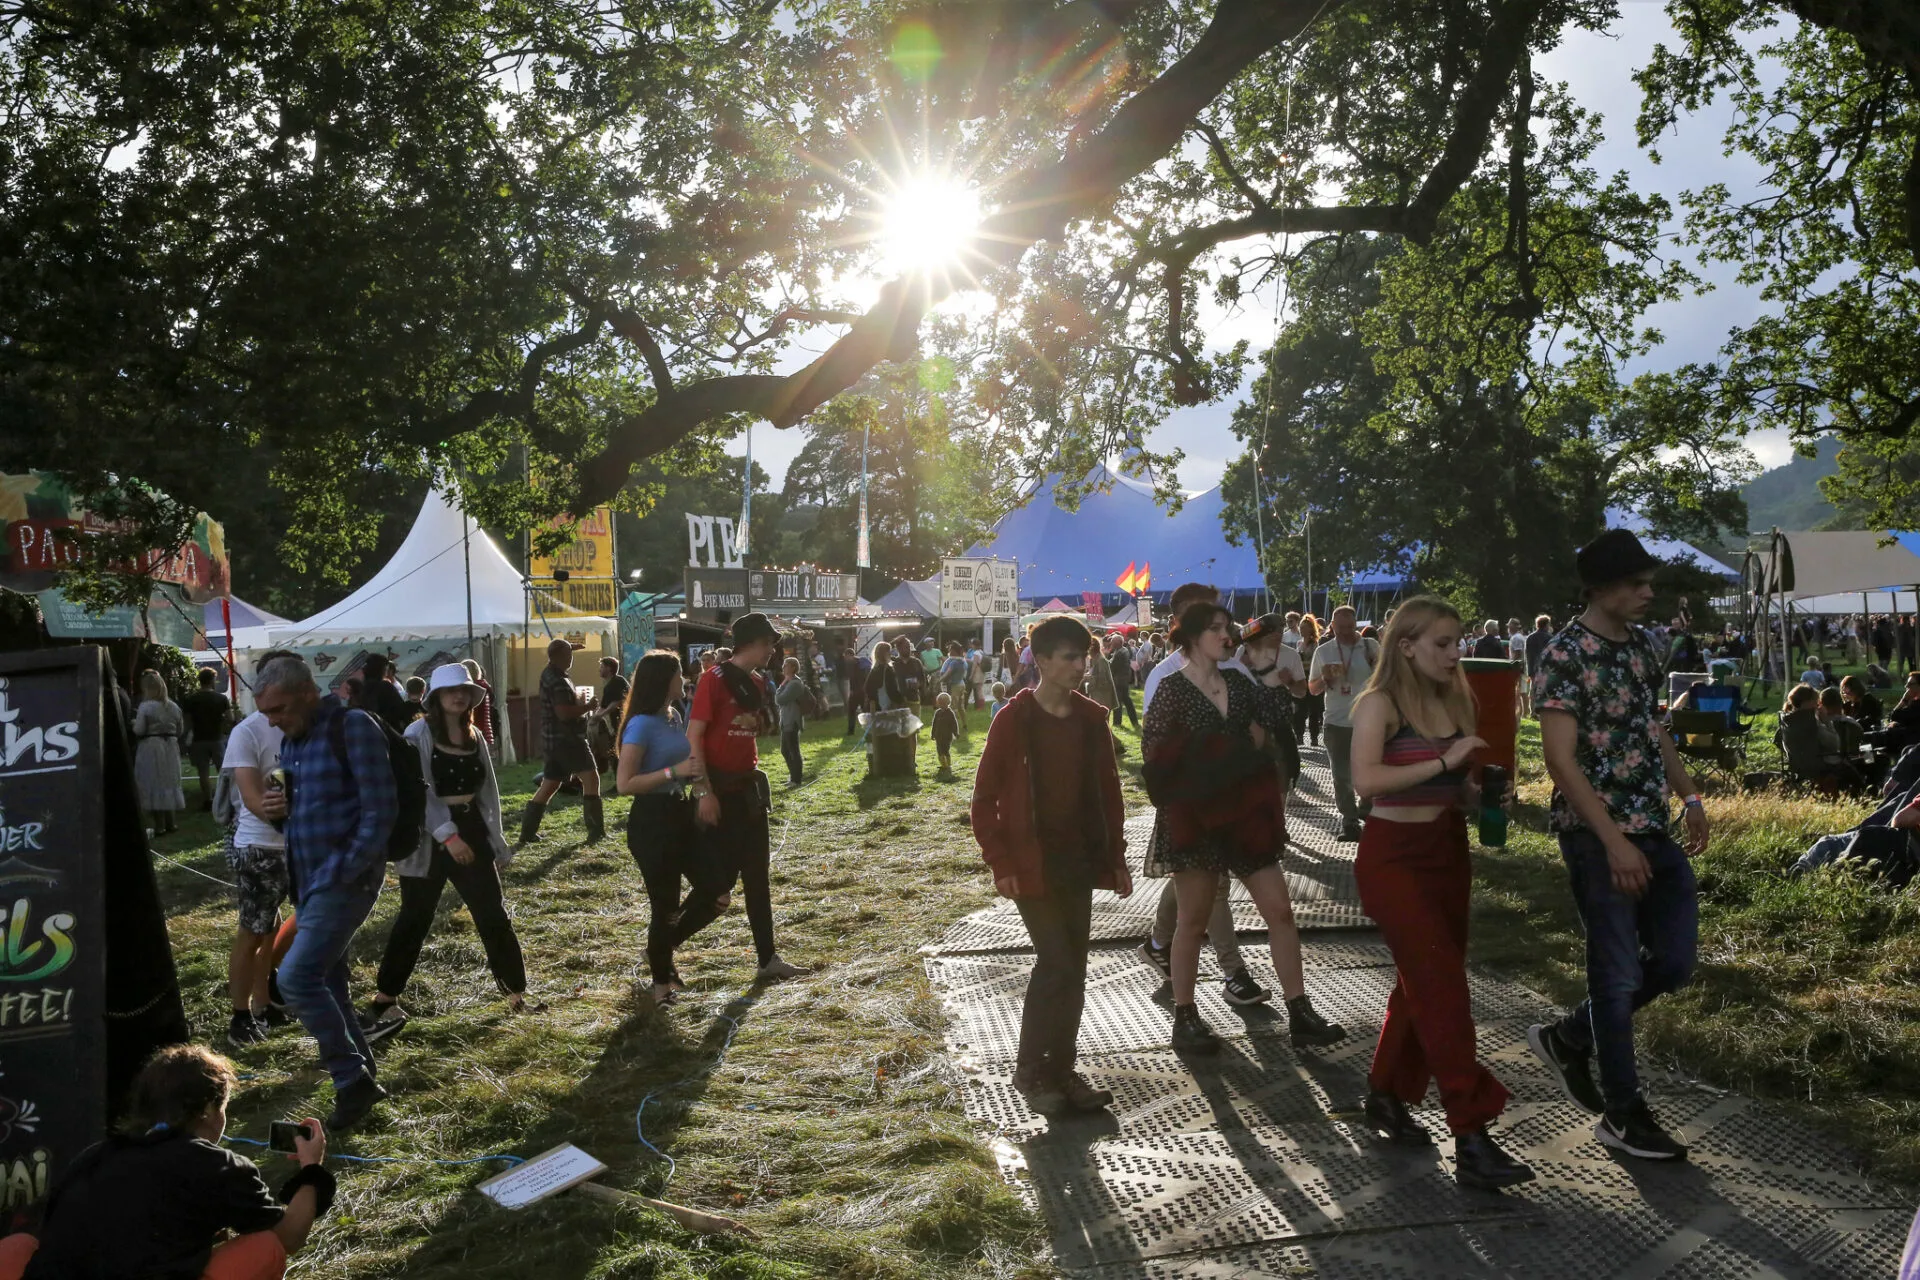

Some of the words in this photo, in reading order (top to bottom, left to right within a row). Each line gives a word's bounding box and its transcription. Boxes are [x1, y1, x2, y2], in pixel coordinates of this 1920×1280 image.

[685, 512, 744, 568] PIE
[570, 582, 611, 612] DRINKS
[776, 574, 798, 598] FISH
[804, 576, 811, 598] &
[815, 576, 840, 598] CHIPS
[953, 579, 973, 591] BURGERS
[703, 594, 718, 608] PIE
[719, 594, 745, 608] MAKER
[994, 600, 1010, 613] FRIES
[624, 614, 653, 645] SHOP
[0, 721, 80, 766] ns
